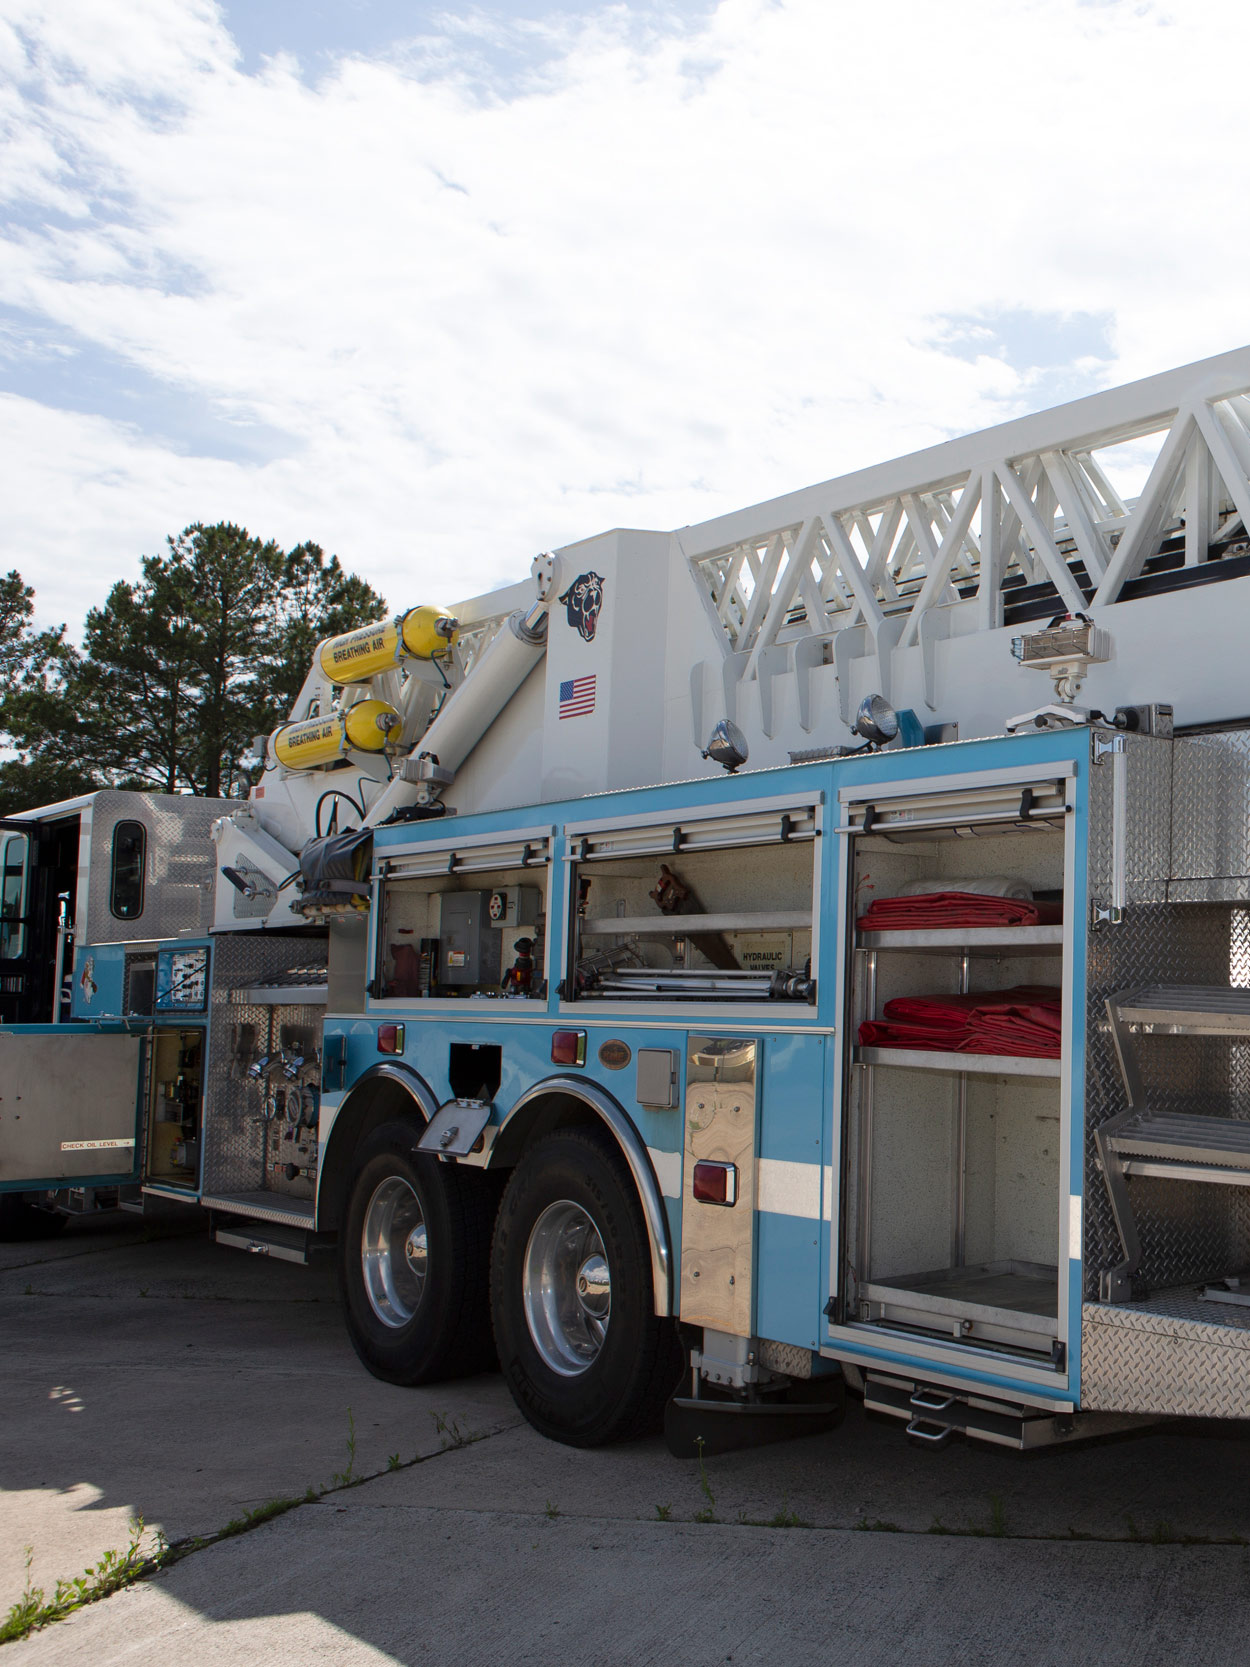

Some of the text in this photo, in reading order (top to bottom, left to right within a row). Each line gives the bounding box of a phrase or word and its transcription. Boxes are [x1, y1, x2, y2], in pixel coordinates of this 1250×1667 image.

[333, 637, 385, 663] BREATHING AIR
[288, 729, 320, 748] BREATHING
[322, 725, 332, 738] AIR
[743, 952, 782, 961] HYDRAULIC
